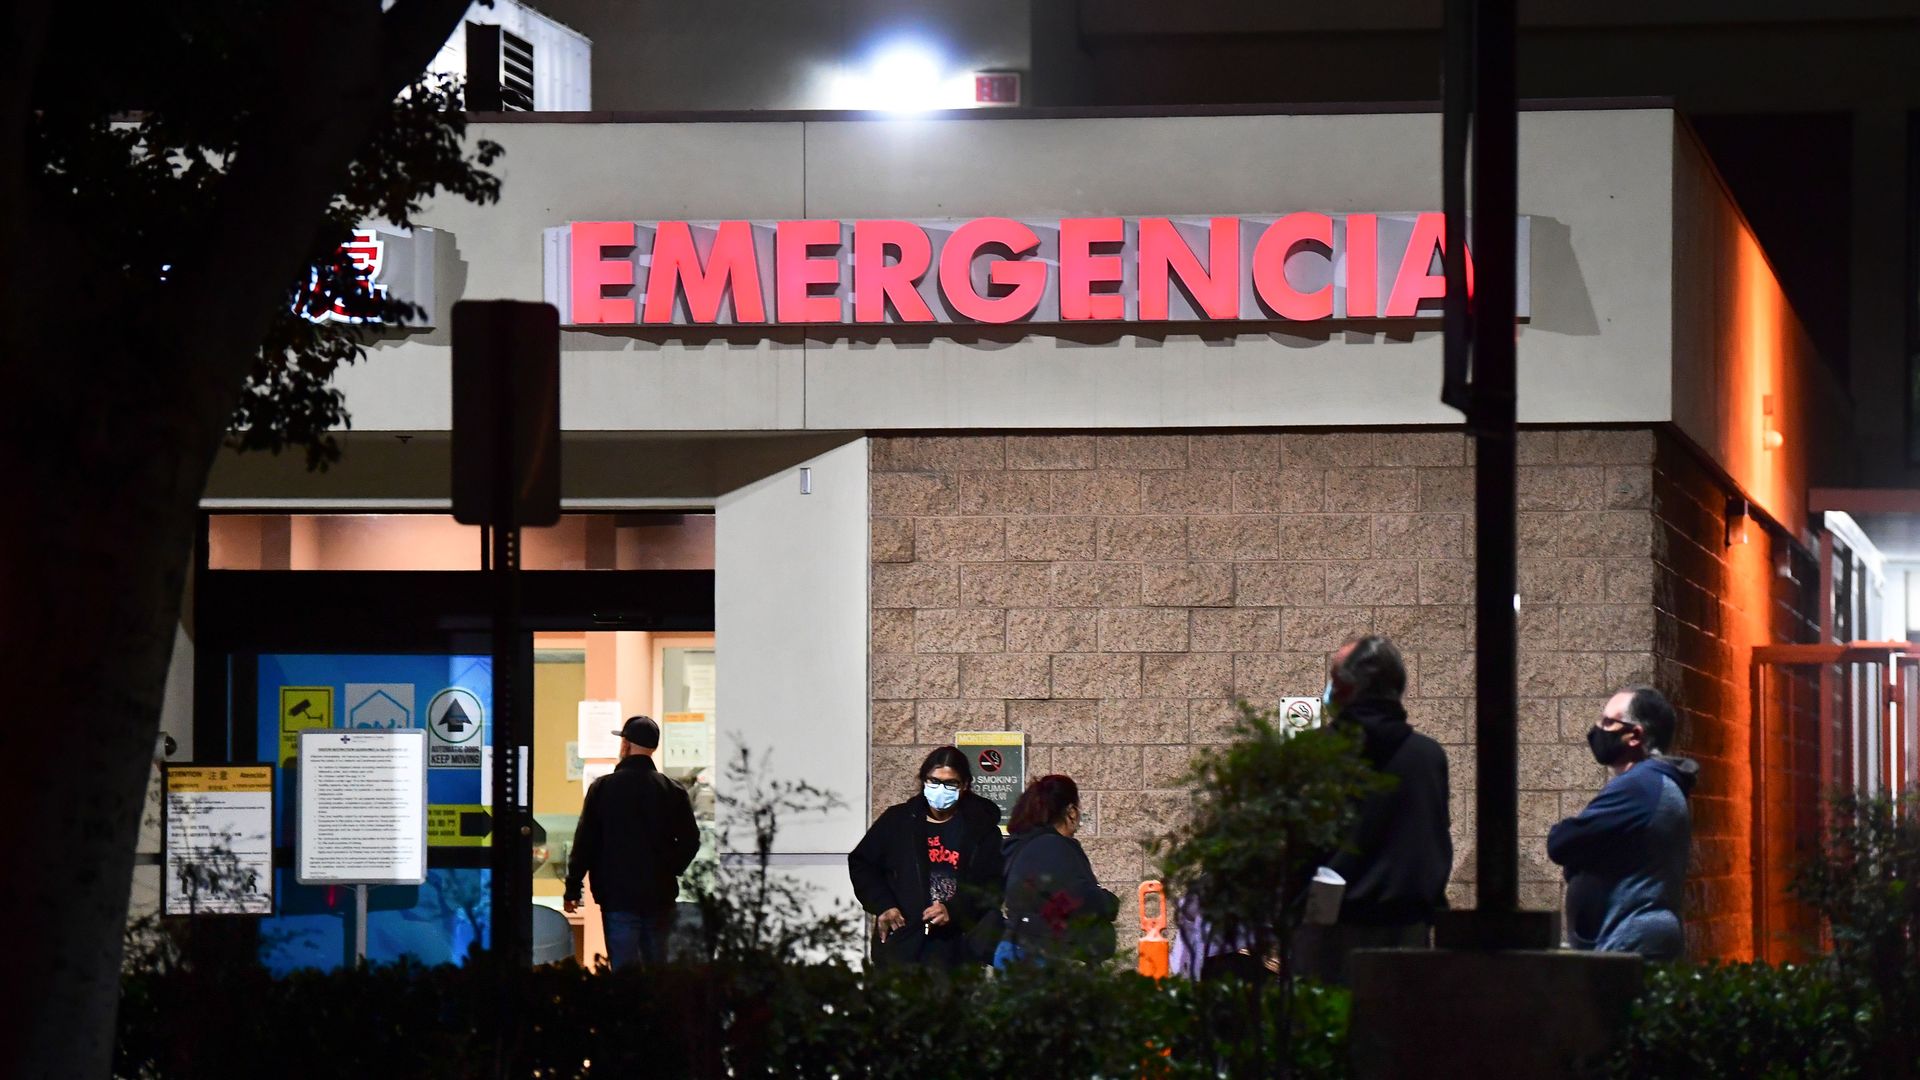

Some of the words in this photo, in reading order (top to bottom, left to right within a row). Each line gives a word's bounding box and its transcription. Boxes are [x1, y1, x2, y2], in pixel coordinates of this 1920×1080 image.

[571, 211, 1475, 324] EMERGENCIA
[431, 755, 450, 764] KEEP
[451, 755, 480, 764] MOVING
[977, 775, 1018, 784] SMOKING
[982, 784, 1013, 792] FUMAR
